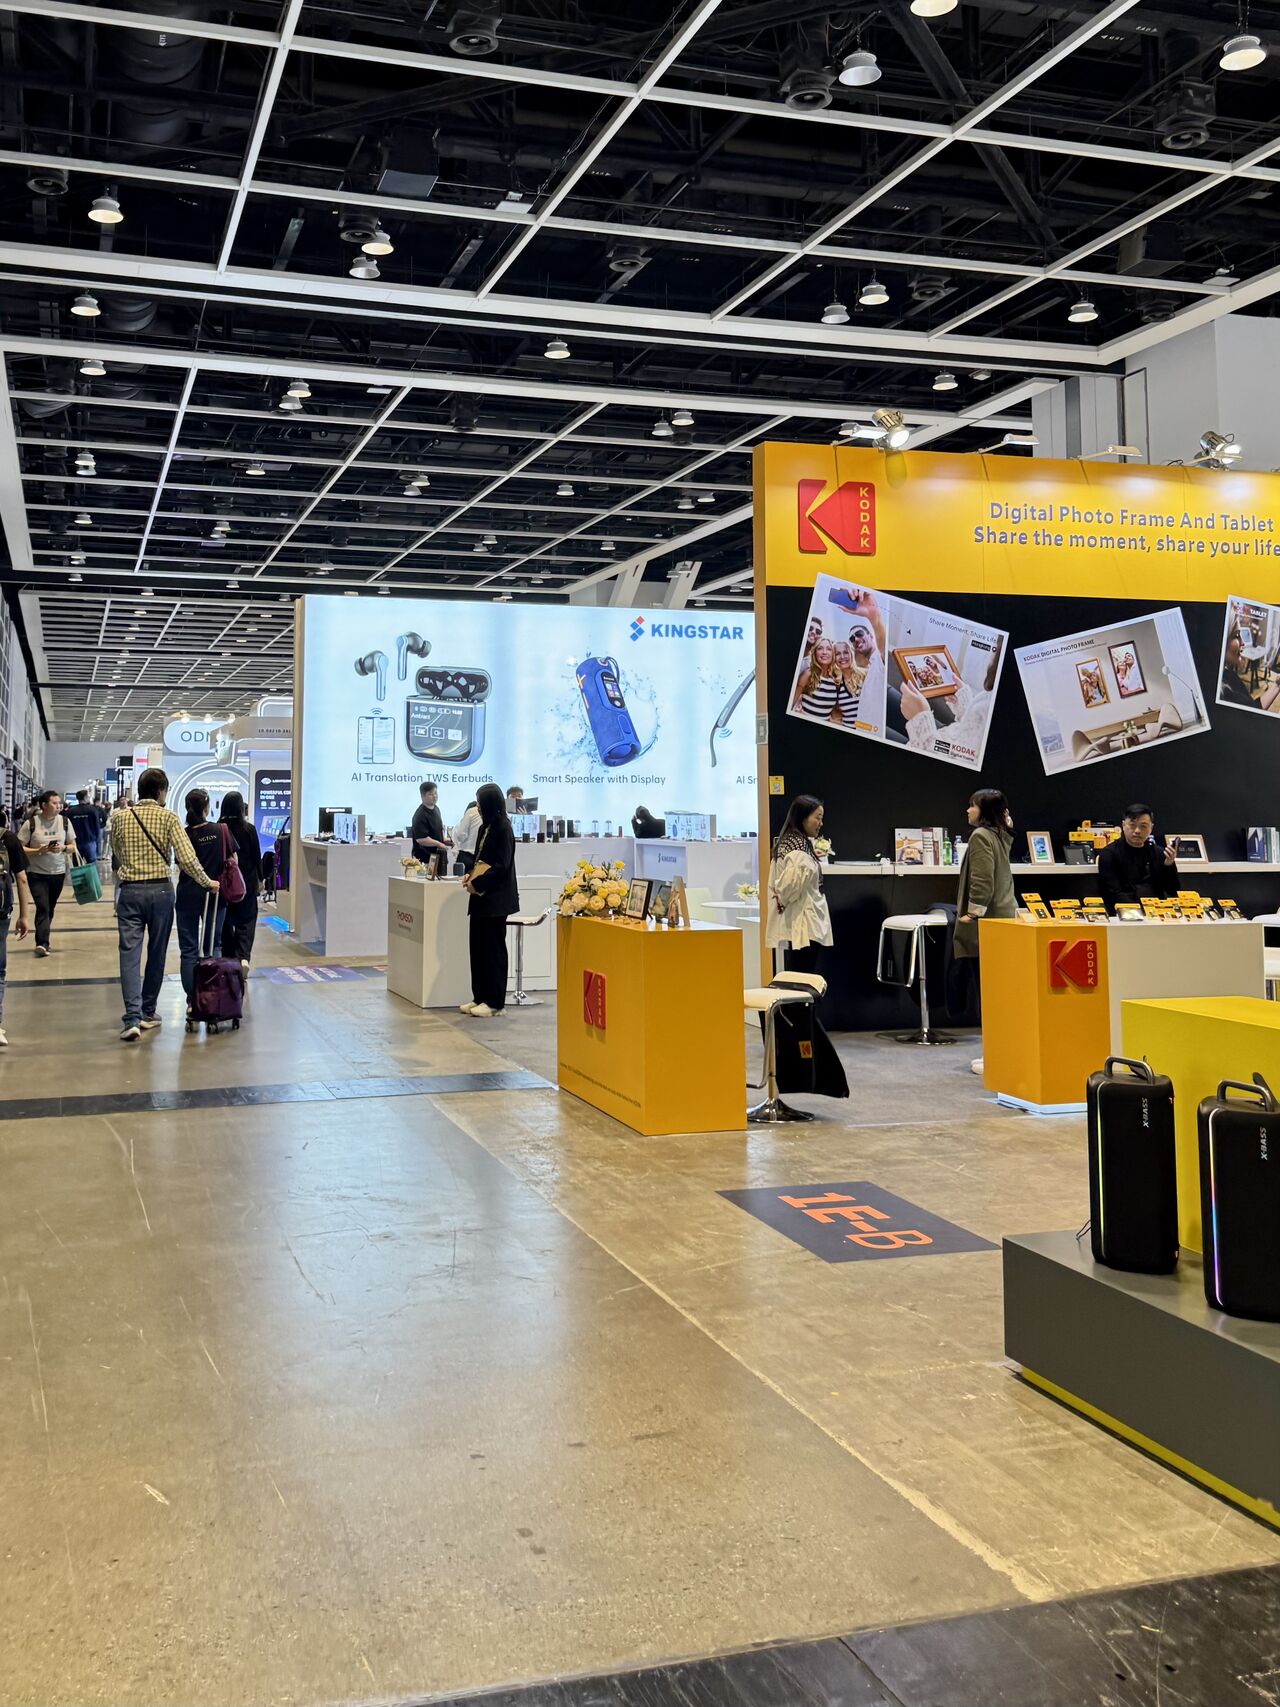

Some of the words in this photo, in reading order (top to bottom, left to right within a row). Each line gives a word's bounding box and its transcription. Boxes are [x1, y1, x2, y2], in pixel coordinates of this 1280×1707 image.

[859, 487, 870, 548] KODAK
[990, 502, 1053, 524] Digital
[1059, 506, 1114, 524] Photo
[1120, 509, 1175, 528] Frame
[1180, 512, 1215, 530] And
[1220, 514, 1274, 533] Tablet
[974, 526, 1028, 545] Share
[1033, 529, 1063, 547] the
[1069, 533, 1151, 552] moment,
[1156, 537, 1205, 553] share
[1210, 541, 1250, 557] your
[651, 623, 744, 640] KINGSTAR
[928, 617, 945, 628] Share
[970, 631, 987, 641] Share
[1023, 653, 1041, 662] KODAK
[1041, 648, 1061, 658] DIGITAL
[1060, 643, 1078, 653] PHOTO
[1078, 639, 1095, 648] FRAME
[951, 743, 976, 757] KODAK
[351, 772, 362, 782] AI
[364, 772, 423, 783] Translation
[426, 773, 449, 783] TWS
[451, 774, 493, 783] Earbuds
[532, 774, 562, 784] Smart
[564, 774, 604, 785] Speaker
[607, 775, 628, 784] with
[630, 775, 666, 786] Display
[736, 775, 745, 785] AI
[777, 1192, 933, 1250] 1E-B
